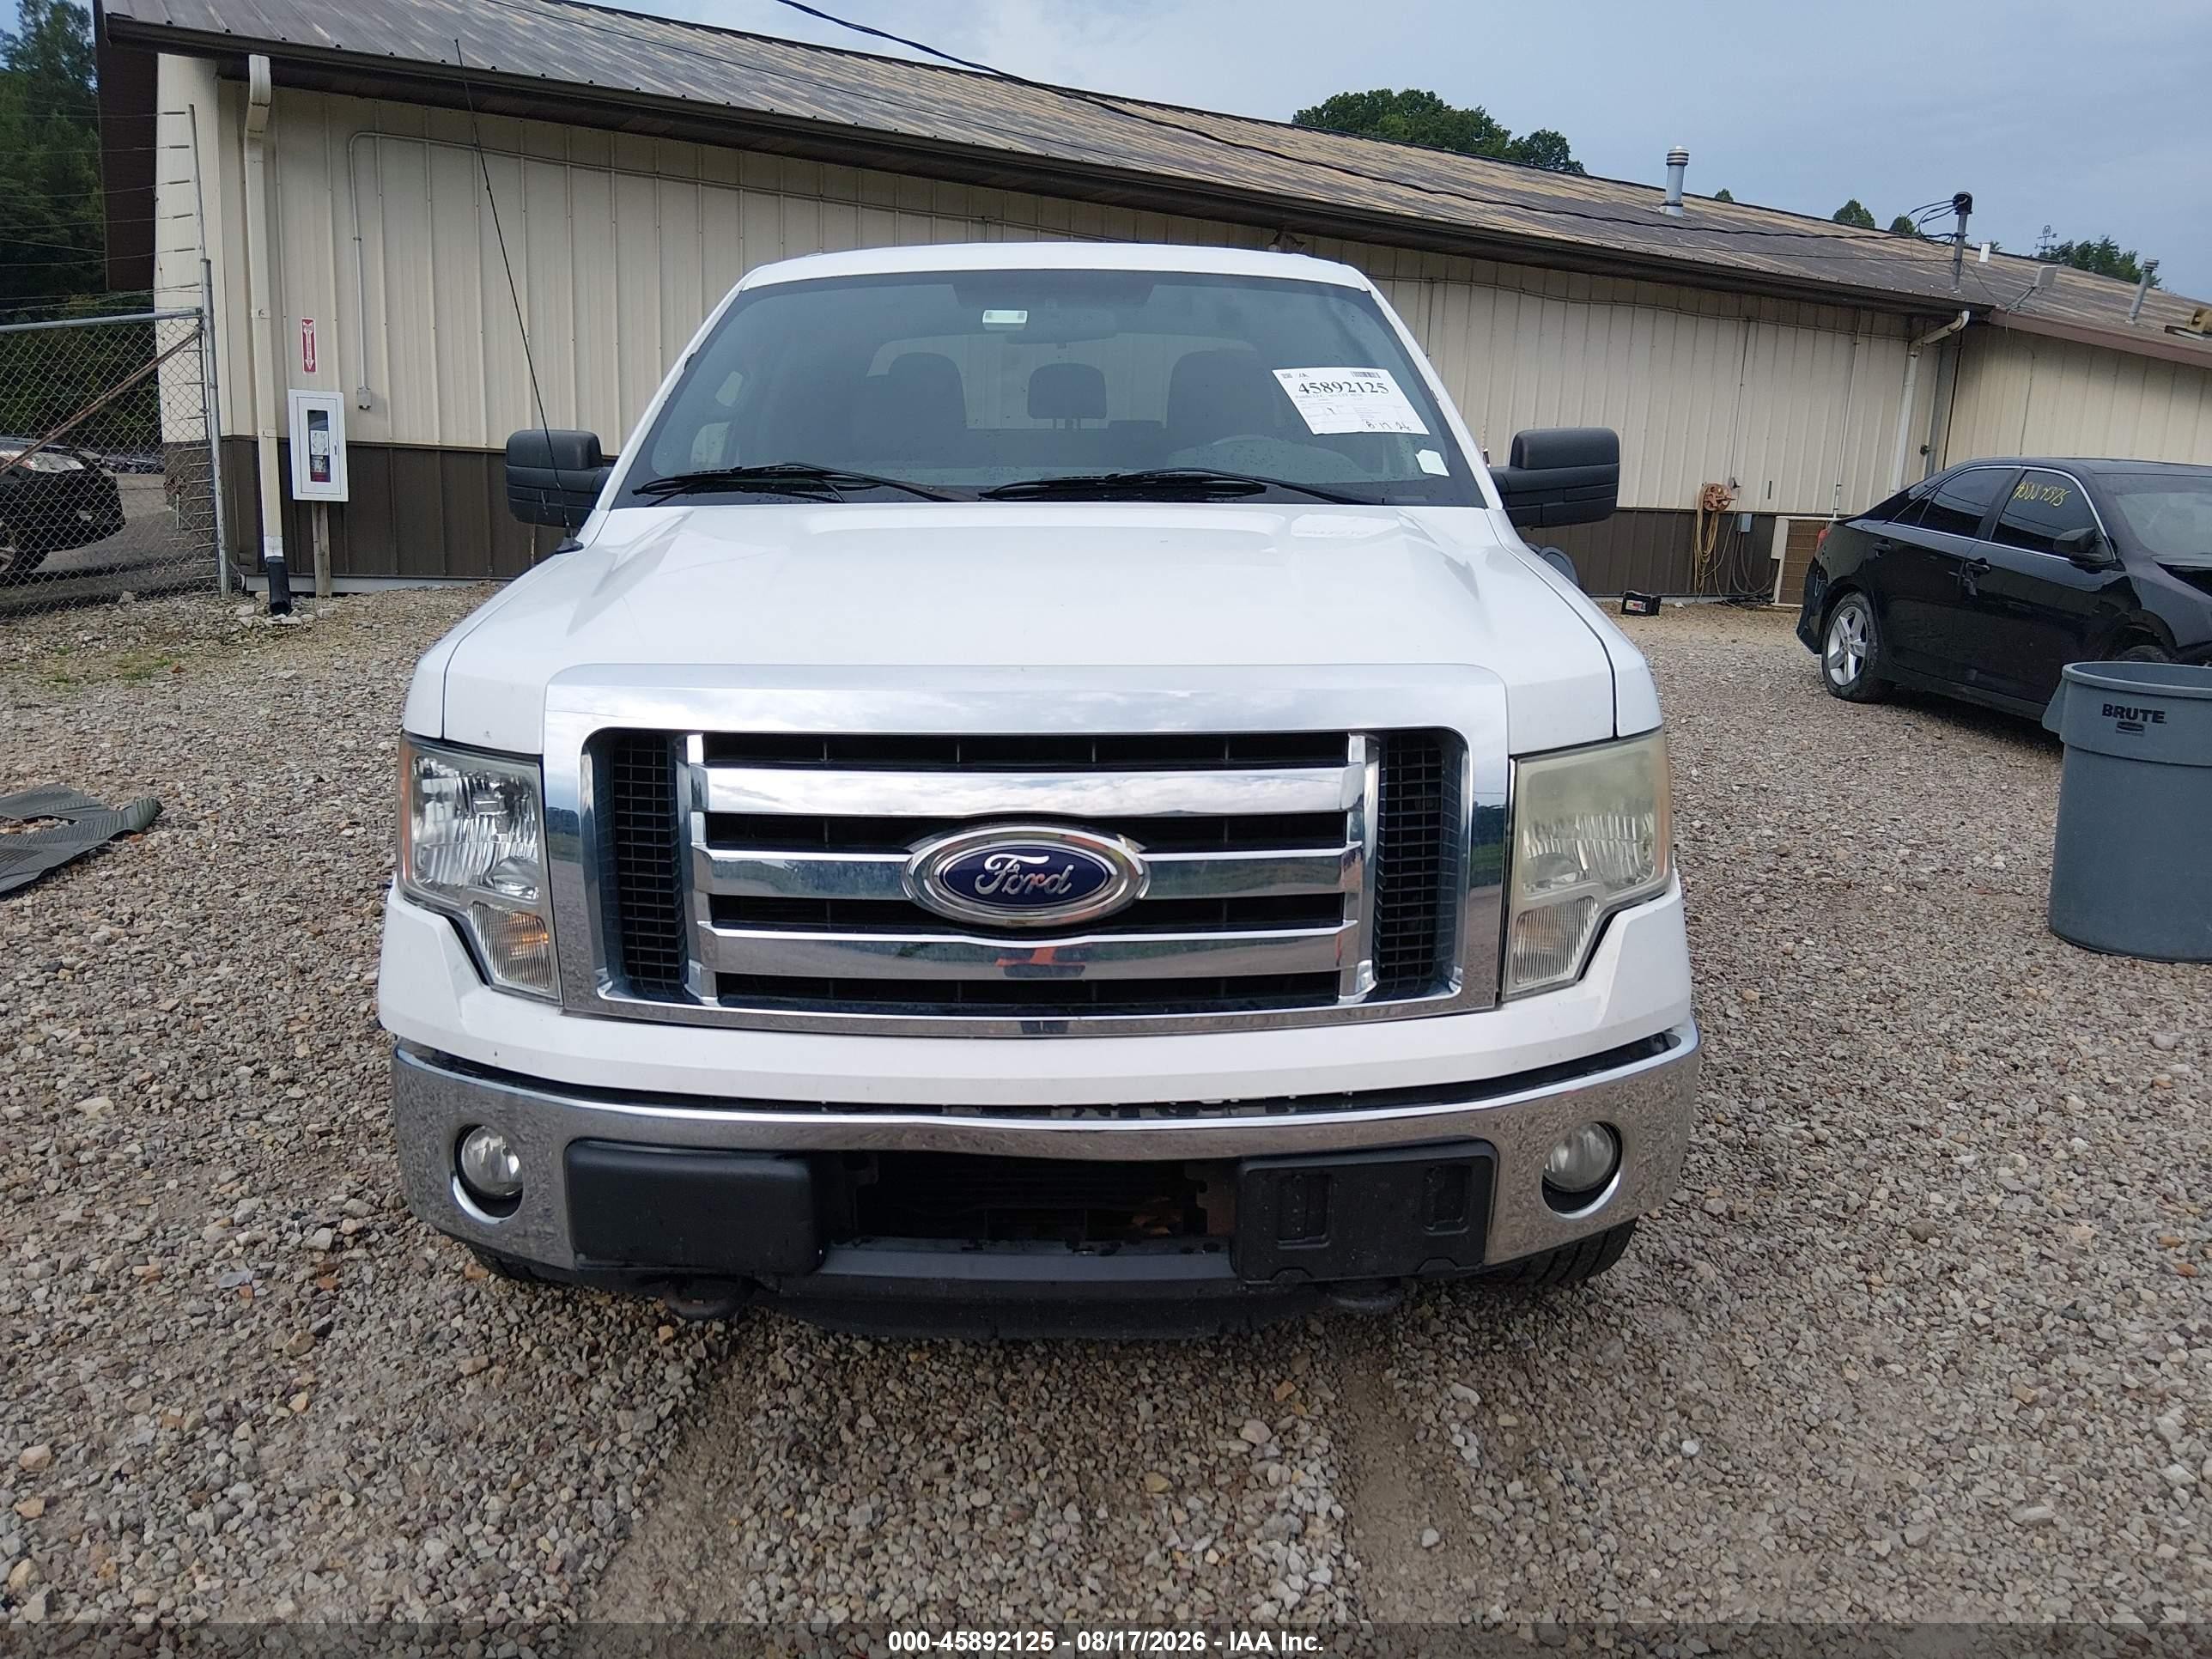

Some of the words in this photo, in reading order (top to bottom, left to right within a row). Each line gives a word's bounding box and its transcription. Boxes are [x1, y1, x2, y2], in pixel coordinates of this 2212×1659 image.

[1298, 381, 1389, 394] 45892125
[2102, 703, 2166, 724] BRUTE
[975, 854, 1074, 895] Ford
